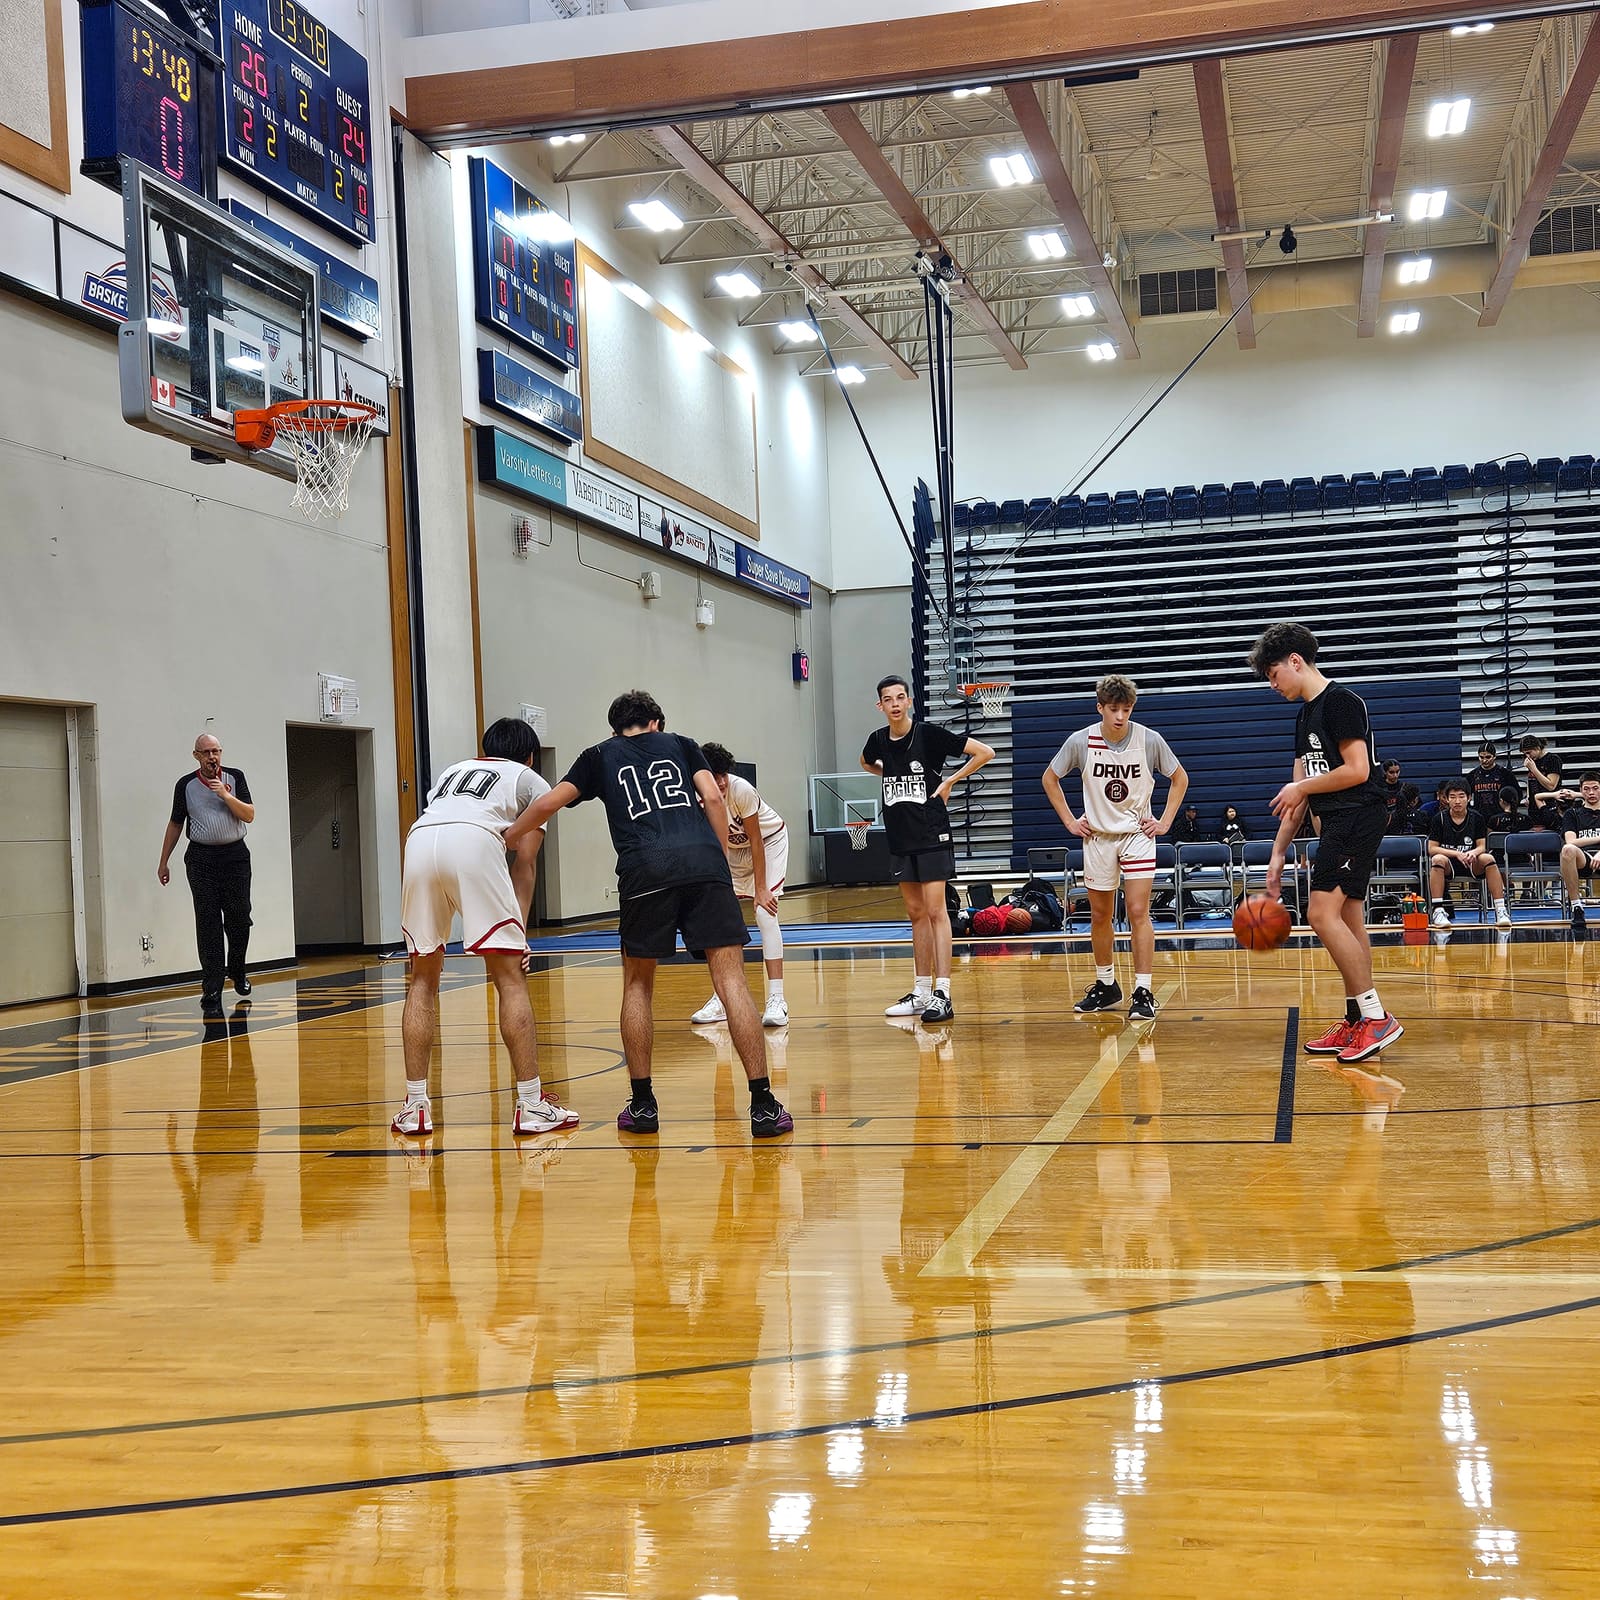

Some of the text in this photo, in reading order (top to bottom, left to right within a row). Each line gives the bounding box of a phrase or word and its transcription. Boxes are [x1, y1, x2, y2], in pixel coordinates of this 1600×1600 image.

[234, 10, 263, 48] HOME
[280, 0, 327, 66] 13:48
[133, 27, 191, 102] 13:48
[240, 42, 269, 98] 26
[290, 63, 313, 89] PERIOD
[232, 84, 255, 110] FOULS
[299, 89, 308, 121] 2
[336, 87, 362, 120] GUEST
[160, 96, 184, 180] 0
[242, 108, 253, 143] 2
[266, 124, 277, 158] 2
[284, 119, 325, 157] PLAYER FOUL
[342, 117, 365, 164] 24
[238, 144, 255, 166] WON
[335, 169, 343, 200] 2
[350, 164, 368, 185] FOULS
[296, 182, 318, 205] MATCH
[357, 185, 368, 216] 0
[355, 217, 369, 236] WON
[326, 261, 331, 275] 3
[532, 258, 538, 283] 2
[553, 252, 570, 274] GUEST
[88, 280, 128, 312] BASKE
[500, 280, 507, 307] 0
[564, 279, 573, 310] 9
[567, 324, 574, 349] 0
[500, 447, 562, 490] VarsityLetters.ca
[572, 470, 603, 507] VARSITY
[605, 492, 634, 521] LETTERS
[746, 554, 763, 579] Super
[764, 563, 779, 584] Save
[779, 570, 801, 594] Disposal
[1092, 762, 1141, 779] DRIVE
[1301, 752, 1324, 760] EST
[432, 768, 502, 801] 10
[616, 758, 692, 821] 12
[883, 781, 927, 806] EAGLES
[901, 774, 925, 782] WEST
[1111, 783, 1122, 799] 2
